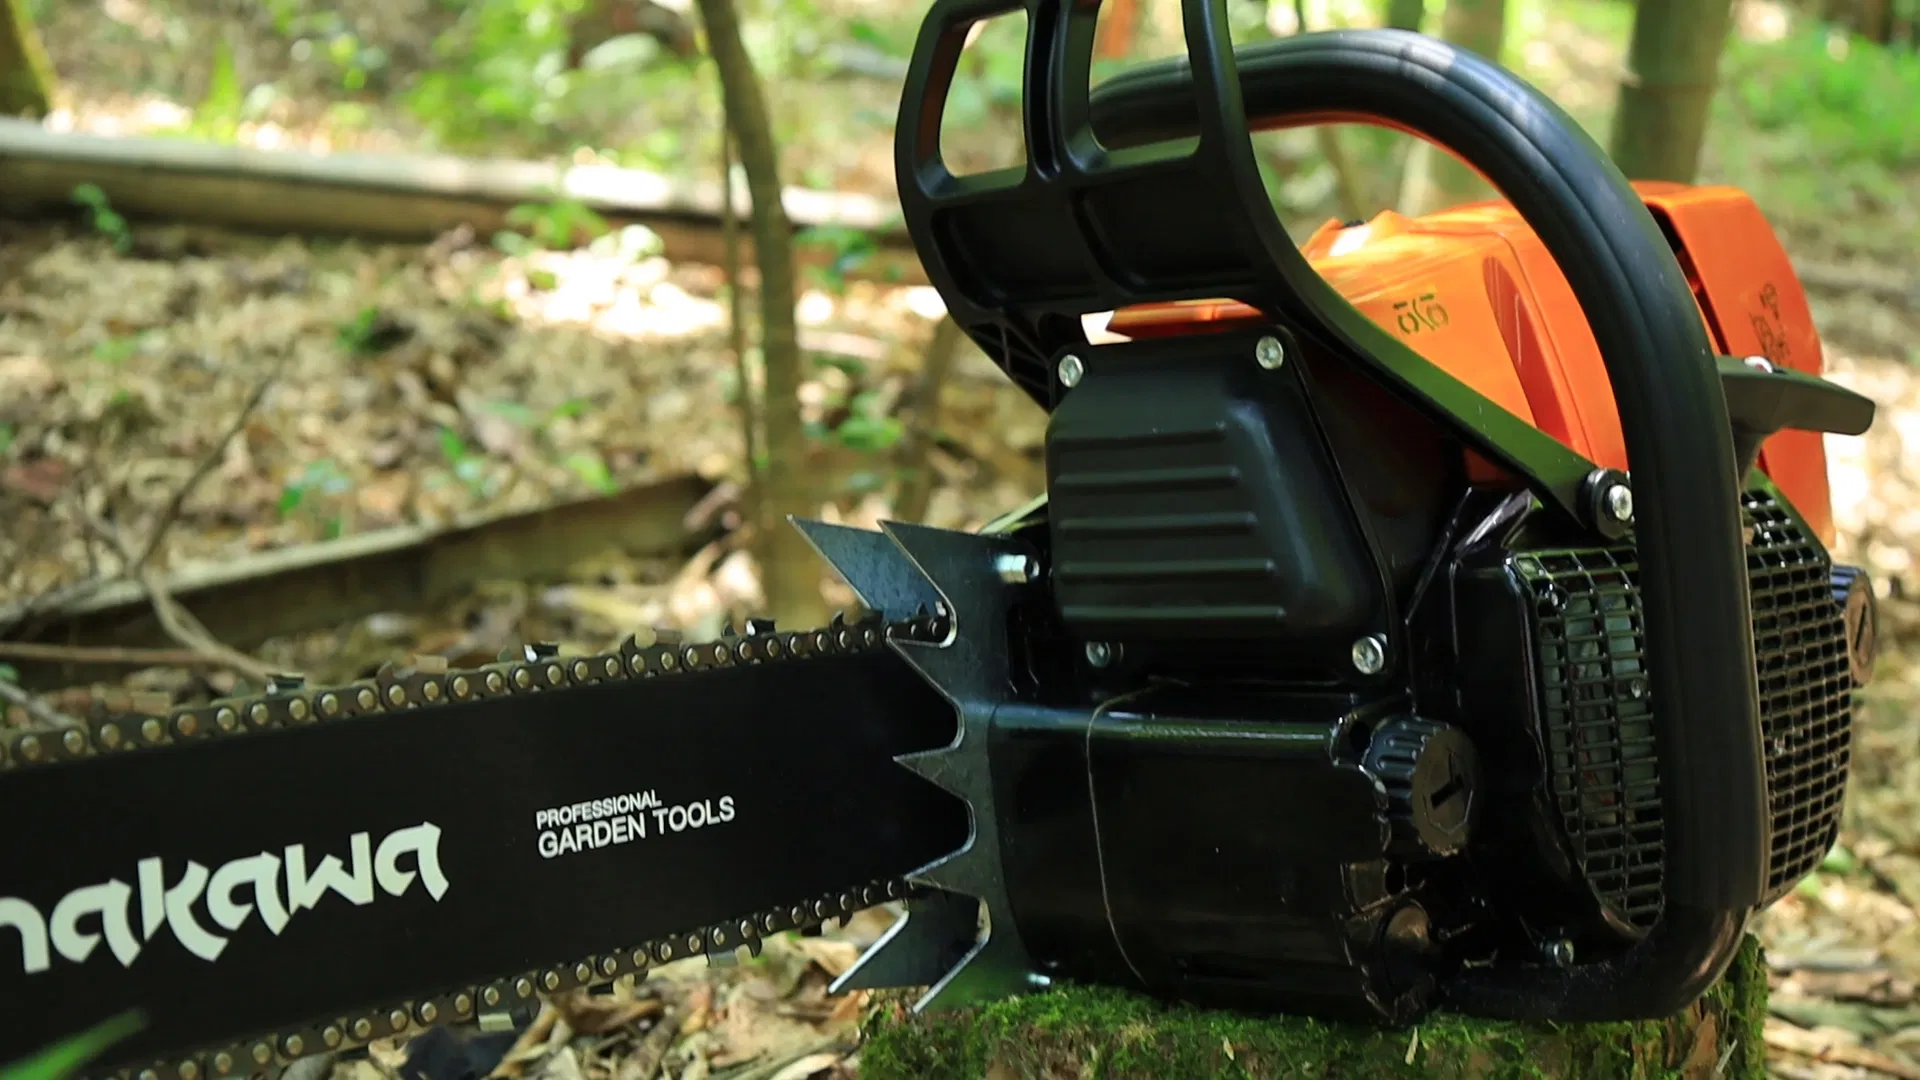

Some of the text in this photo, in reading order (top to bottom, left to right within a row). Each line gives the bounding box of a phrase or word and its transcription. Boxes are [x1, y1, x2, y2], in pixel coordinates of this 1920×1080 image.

[535, 789, 663, 830] PROFESSIONAL
[537, 795, 736, 859] GARDEN TOOLS
